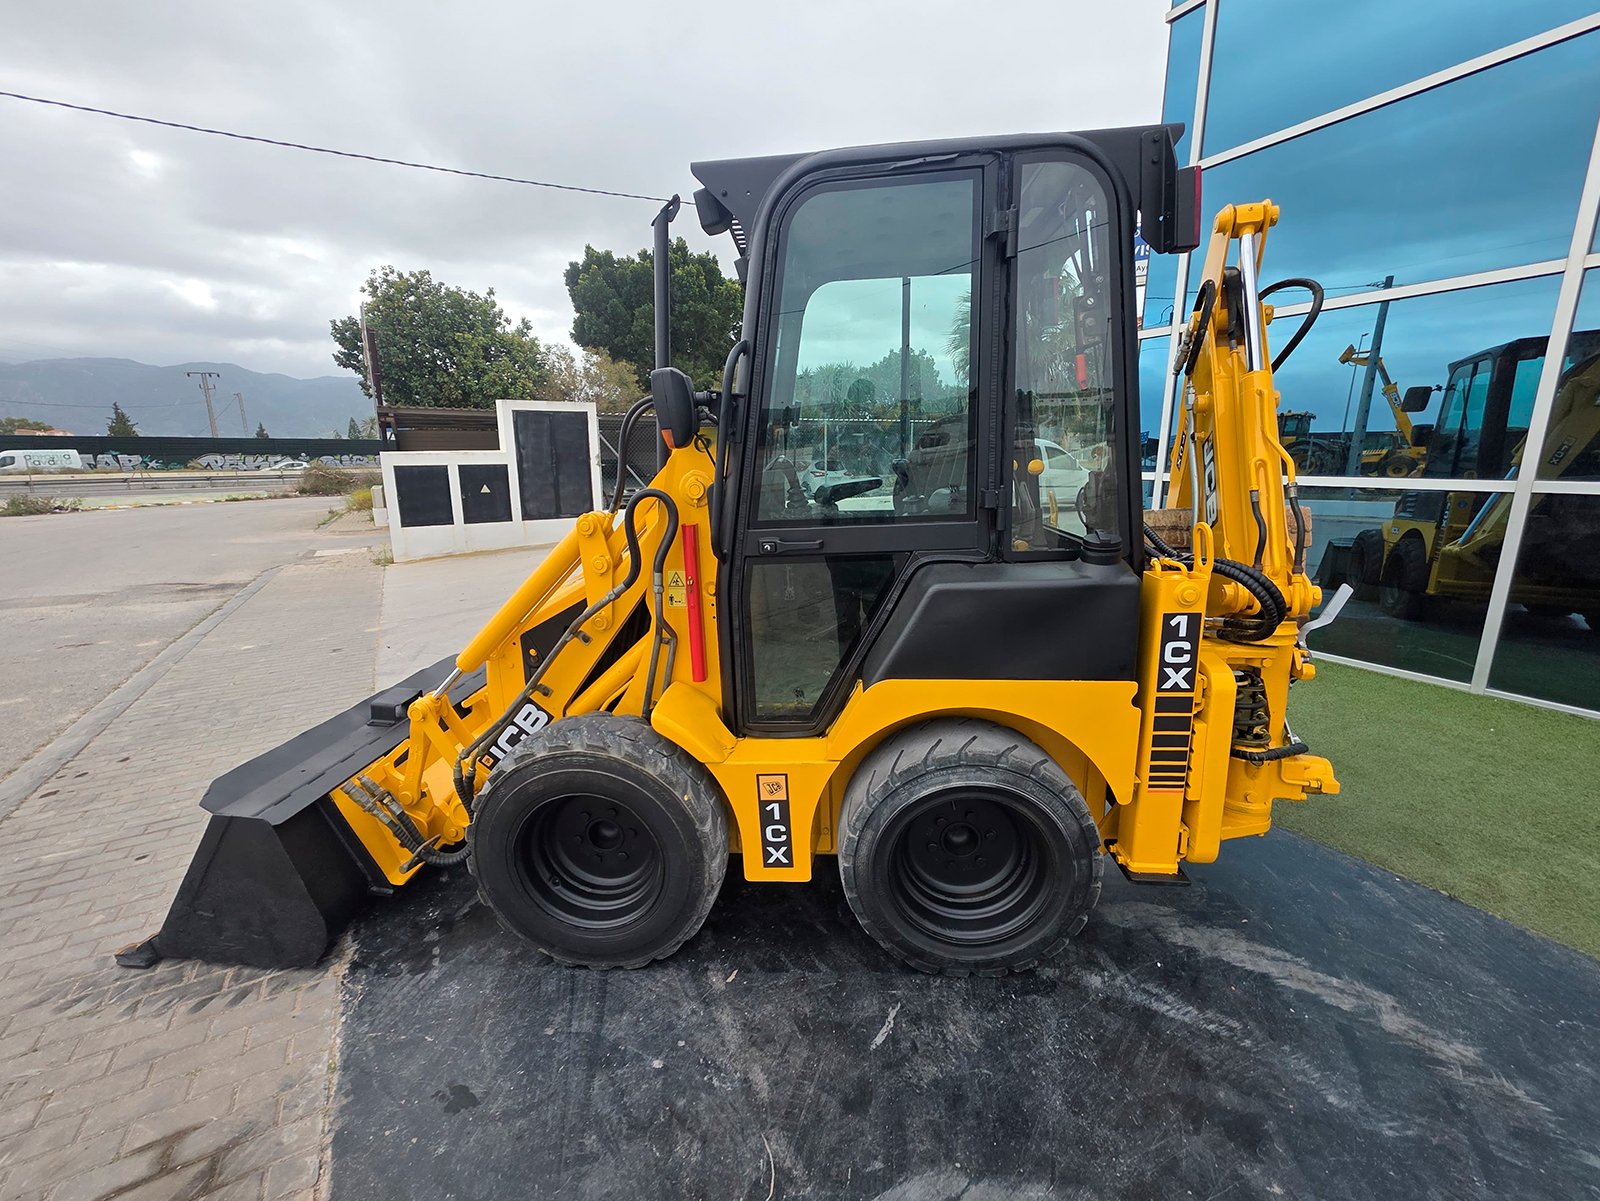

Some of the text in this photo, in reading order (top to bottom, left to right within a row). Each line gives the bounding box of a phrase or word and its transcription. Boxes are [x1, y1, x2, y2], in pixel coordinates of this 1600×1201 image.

[1203, 441, 1217, 527] JCB
[1161, 614, 1193, 689] 1CX
[766, 783, 782, 794] JCB
[765, 802, 789, 864] 1CX
